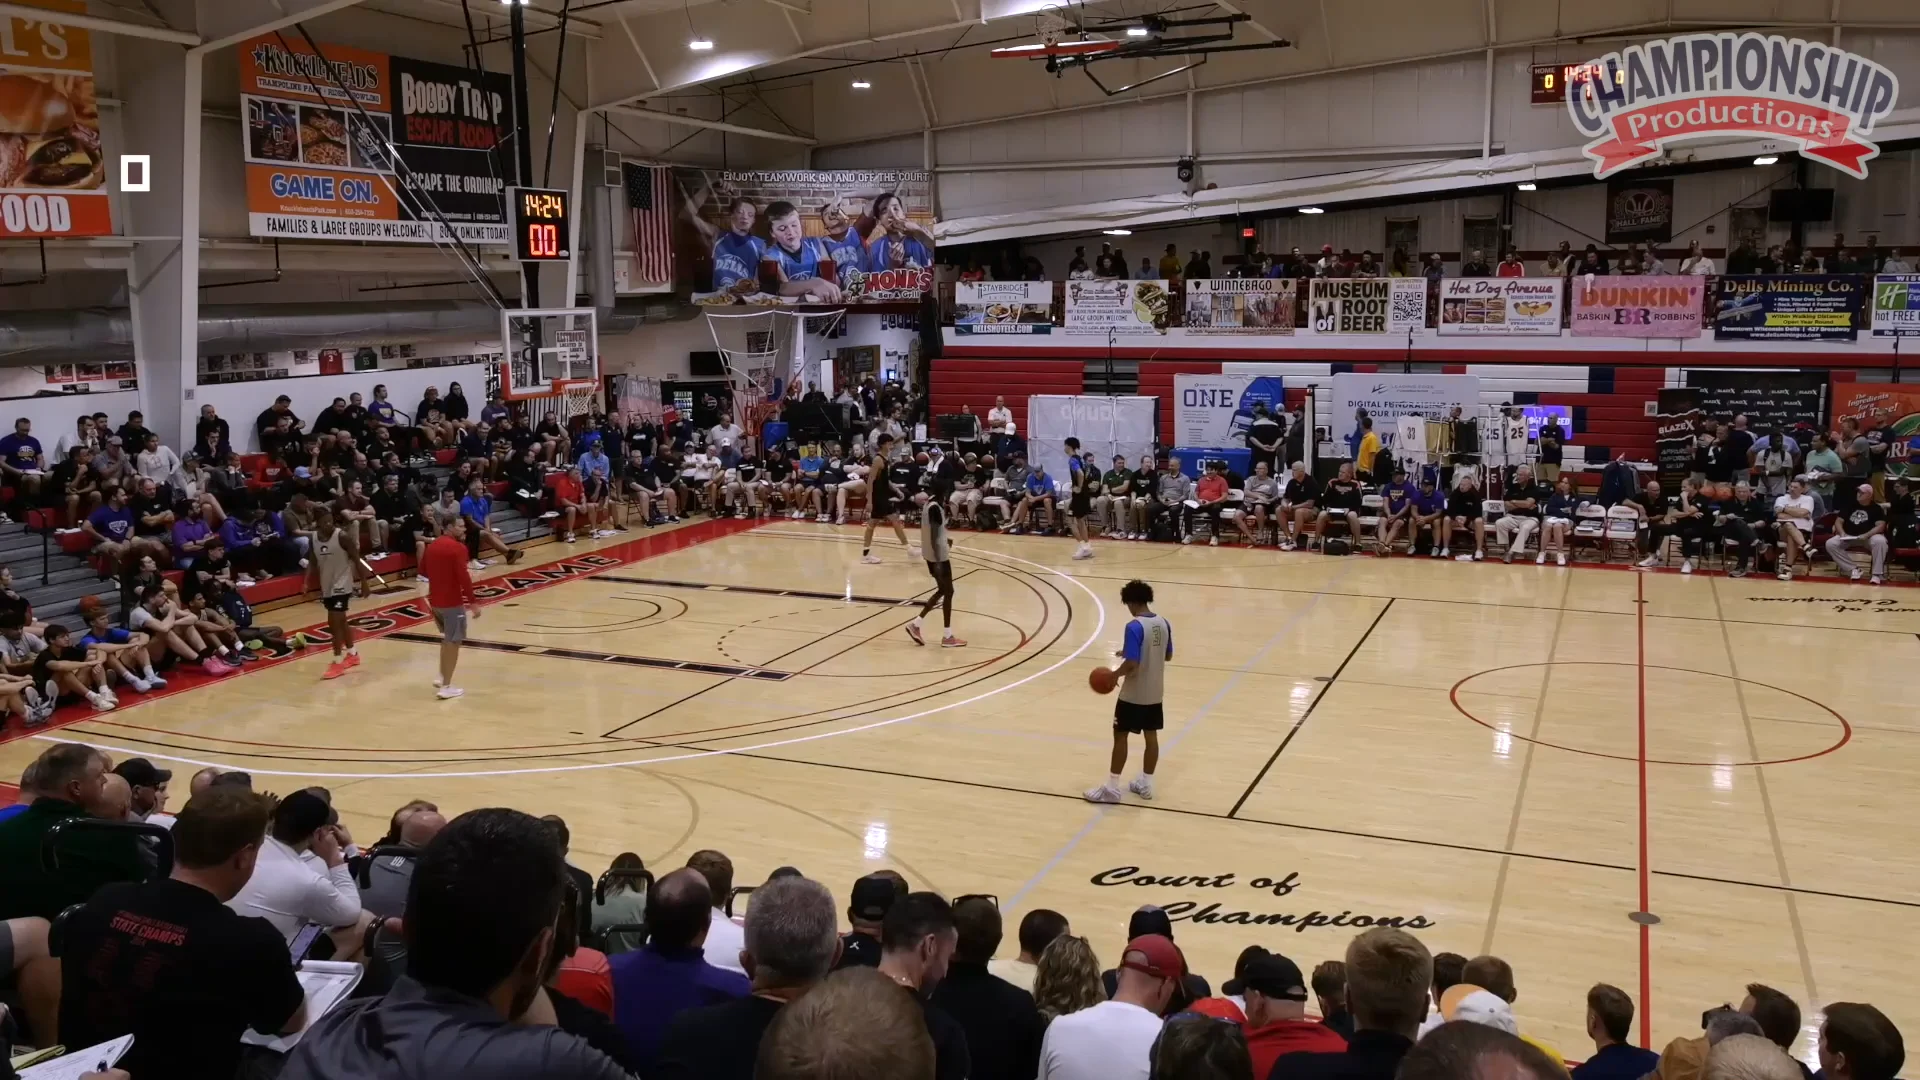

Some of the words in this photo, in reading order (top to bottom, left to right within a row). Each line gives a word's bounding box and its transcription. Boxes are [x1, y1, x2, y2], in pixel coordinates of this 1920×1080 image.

[1544, 74, 1554, 89] 0
[401, 72, 457, 115] BOOBY
[444, 174, 460, 194] THE
[723, 171, 755, 182] ENJOY
[758, 172, 816, 183] TEAMWORK
[818, 172, 833, 183] ON
[834, 172, 856, 183] AND
[858, 172, 875, 183] OFF
[876, 172, 896, 183] THE
[897, 172, 929, 183] COURT
[270, 172, 336, 201] GAME
[339, 178, 380, 205] ON.
[0, 193, 72, 234] OOD
[524, 194, 563, 219] 14:24
[266, 217, 309, 235] FAMILIES
[310, 220, 319, 235] &
[321, 220, 347, 236] LARGE
[349, 221, 381, 238] GROUPS
[383, 222, 425, 239] WELCOME!
[460, 225, 485, 241] ONLINE
[485, 226, 509, 241] TODAY!
[528, 223, 557, 256] 00
[864, 267, 933, 295] MONK'S
[982, 284, 1024, 292] STAYBRIDGE
[1210, 280, 1272, 291] WINNEBAGO
[1723, 280, 1764, 293] Dells
[1766, 280, 1825, 296] Mining
[1827, 279, 1855, 292] Co.
[878, 291, 893, 299] Bar
[903, 290, 920, 299] Grill
[1314, 282, 1388, 298] MUSEUM
[1449, 281, 1471, 294] Hot
[1475, 281, 1501, 299] Dog
[1504, 281, 1554, 294] Avenue
[1580, 286, 1697, 308] DUNKIN'
[1316, 315, 1335, 332] of
[1342, 299, 1388, 315] ROOT
[1340, 316, 1385, 332] BEER
[1576, 313, 1611, 321] BASKIN
[1613, 308, 1652, 325] BR
[1654, 313, 1696, 321] ROBBINS
[1874, 310, 1889, 321] hot
[1892, 310, 1915, 321] FREE
[972, 324, 1033, 334] DELLSHOTELS.COM
[327, 354, 335, 363] 3
[1183, 388, 1234, 408] ONE
[1348, 400, 1382, 409] DIGITAL
[1847, 393, 1890, 408] Ingredients
[1367, 410, 1389, 418] YOUR
[1857, 404, 1869, 412] for
[1406, 426, 1416, 441] 33
[1510, 426, 1524, 440] 25
[1658, 419, 1696, 434] BLAZEX
[472, 553, 623, 600] GAME
[1090, 865, 1235, 888] Court
[1249, 871, 1302, 897] of
[1157, 901, 1436, 933] Champions
[110, 916, 139, 935] STATE
[137, 924, 186, 947] CHAMPS
